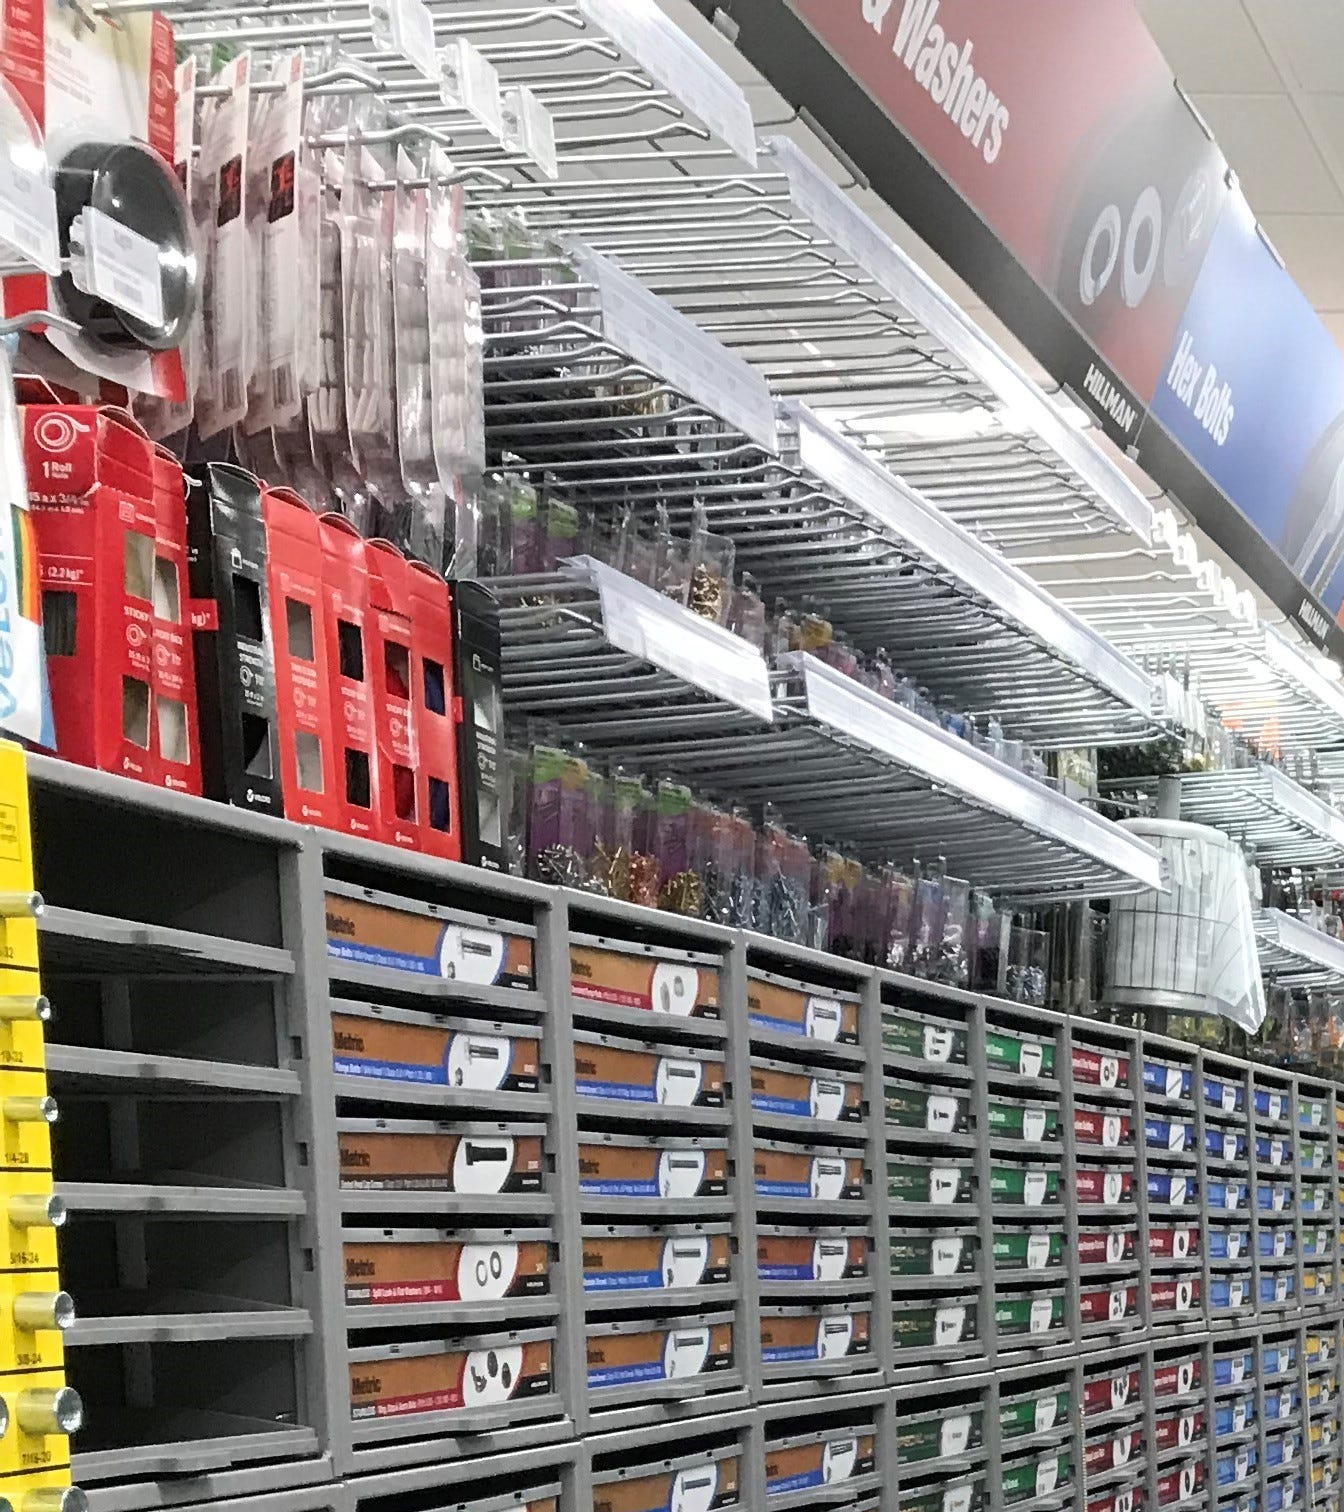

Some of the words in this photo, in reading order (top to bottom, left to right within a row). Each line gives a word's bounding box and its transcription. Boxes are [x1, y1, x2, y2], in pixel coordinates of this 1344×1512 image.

[892, 0, 1009, 163] Washers
[1083, 363, 1135, 432] HILLMAN
[1167, 331, 1202, 408] Hex
[1194, 364, 1234, 446] Bolts
[52, 462, 72, 473] Roll
[334, 1031, 364, 1052] Metric
[340, 1149, 370, 1166] Metric
[346, 1258, 375, 1276] Metric
[352, 1376, 381, 1395] Metric
